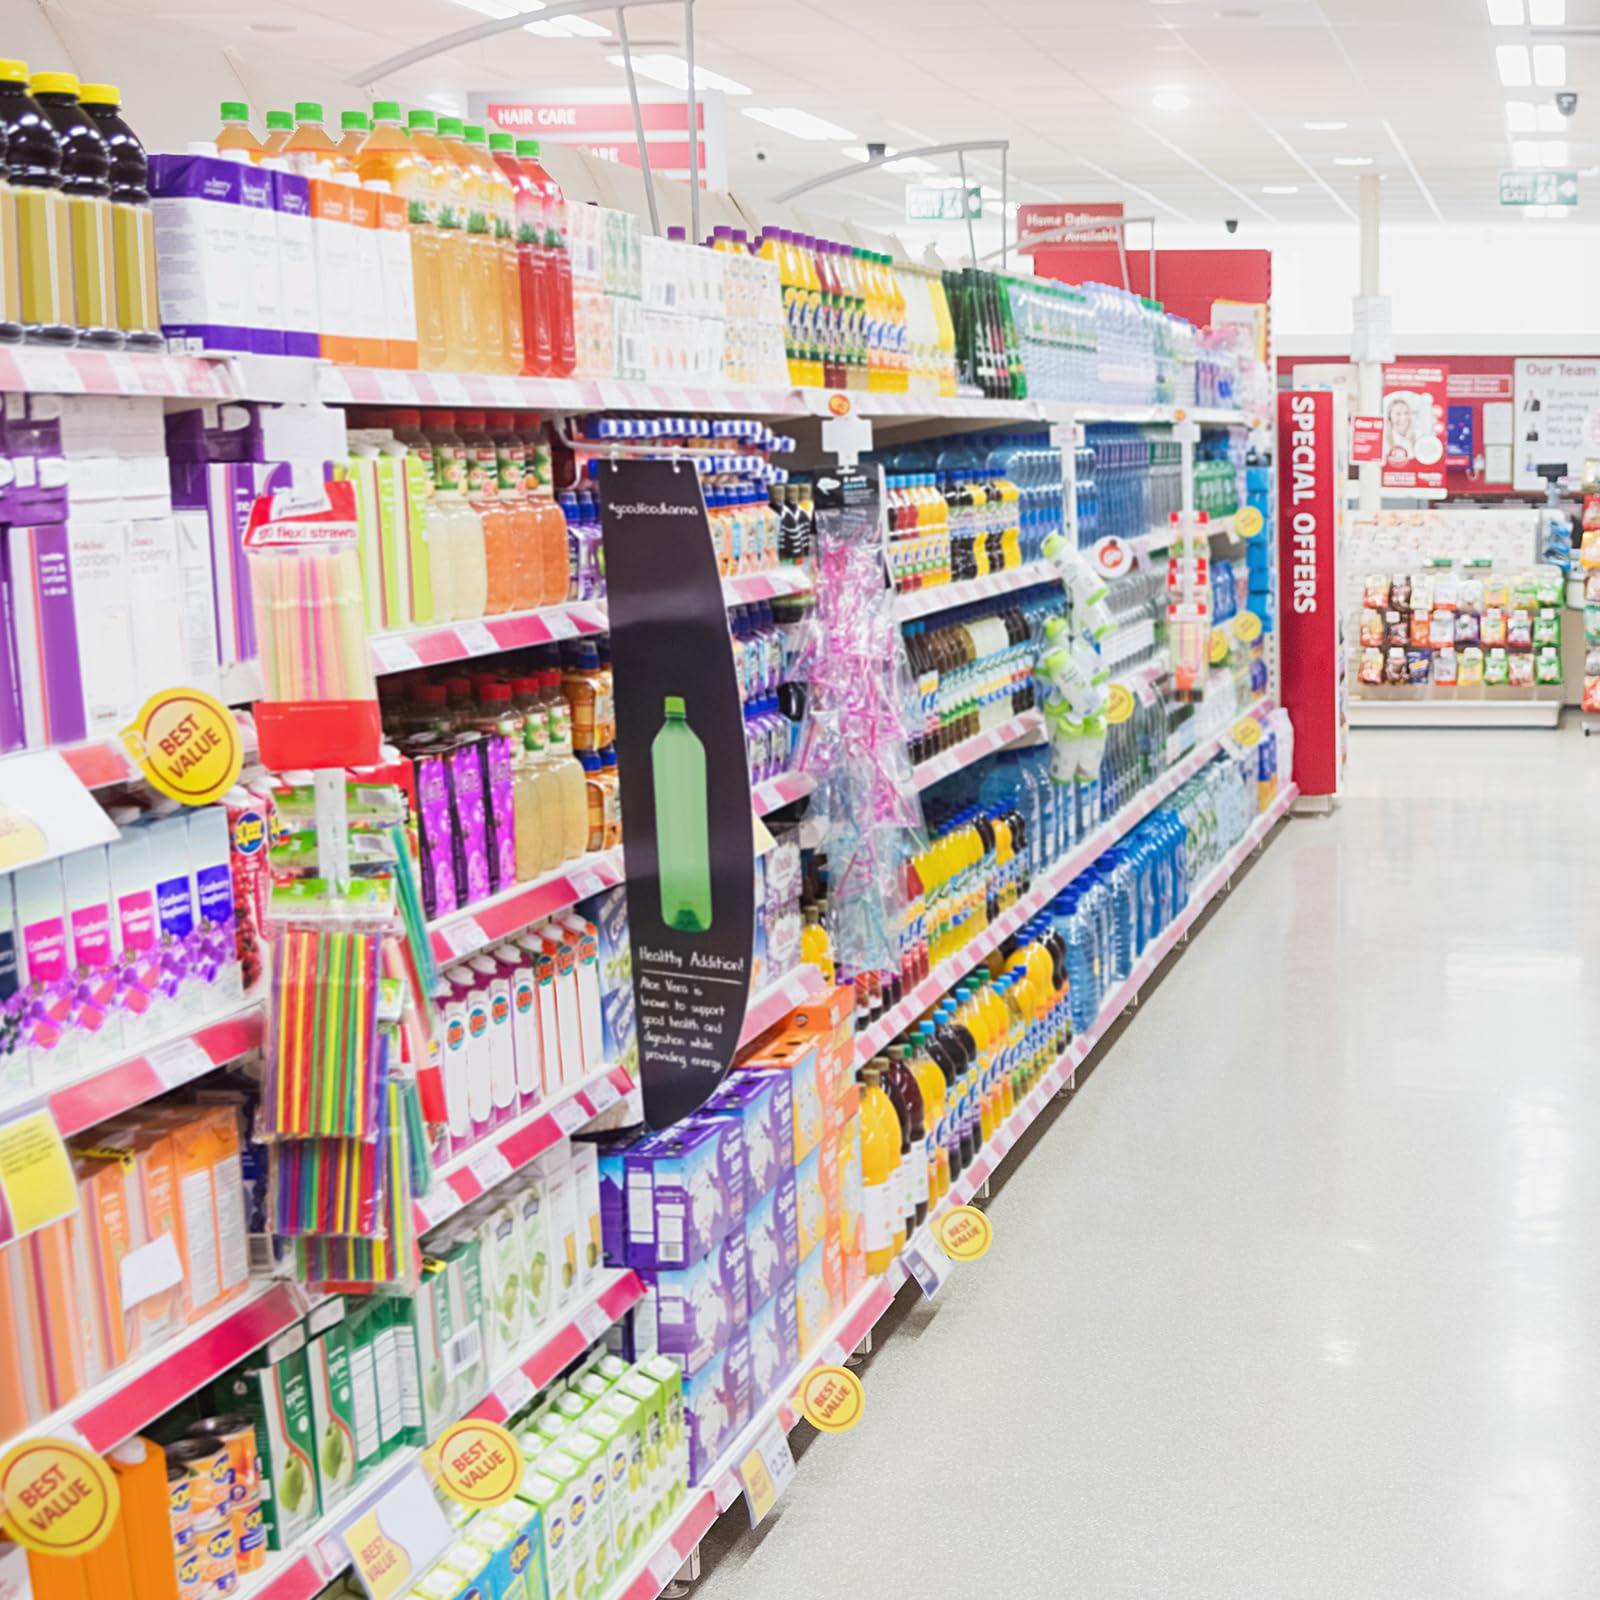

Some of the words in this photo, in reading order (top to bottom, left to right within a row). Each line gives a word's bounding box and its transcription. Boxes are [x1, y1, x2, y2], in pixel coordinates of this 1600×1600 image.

[498, 108, 533, 126] HAIR
[539, 108, 577, 126] CARE
[1026, 213, 1061, 227] Home
[1526, 363, 1552, 375] Our
[1559, 363, 1597, 376] Team
[1291, 396, 1315, 506] SPECIAL
[310, 528, 357, 538] straws
[1292, 512, 1317, 613] OFFERS
[158, 713, 199, 757] BEST
[167, 727, 222, 779] VALUE
[640, 946, 683, 968] Healthy
[690, 951, 744, 972] Addition!
[640, 976, 661, 990] Aloe
[665, 979, 688, 994] Vera
[693, 984, 703, 997] is
[640, 995, 670, 1009] known
[675, 1000, 687, 1012] to
[691, 1004, 725, 1017] support
[642, 1016, 665, 1029] good
[669, 1016, 700, 1030] health
[704, 1023, 722, 1034] and
[643, 1031, 686, 1048] digestion
[690, 1036, 713, 1050] while
[645, 1051, 687, 1069] providing
[948, 1218, 971, 1238] BEST
[952, 1226, 980, 1248] VALUE
[814, 1378, 837, 1408] BEST
[821, 1385, 850, 1419] VALUE
[452, 1439, 488, 1473] BEST
[459, 1450, 507, 1489] VALUE
[18, 1463, 66, 1508] BEST
[28, 1477, 93, 1531] VALUE
[360, 1535, 385, 1565] BEST
[367, 1550, 397, 1583] VALUE
